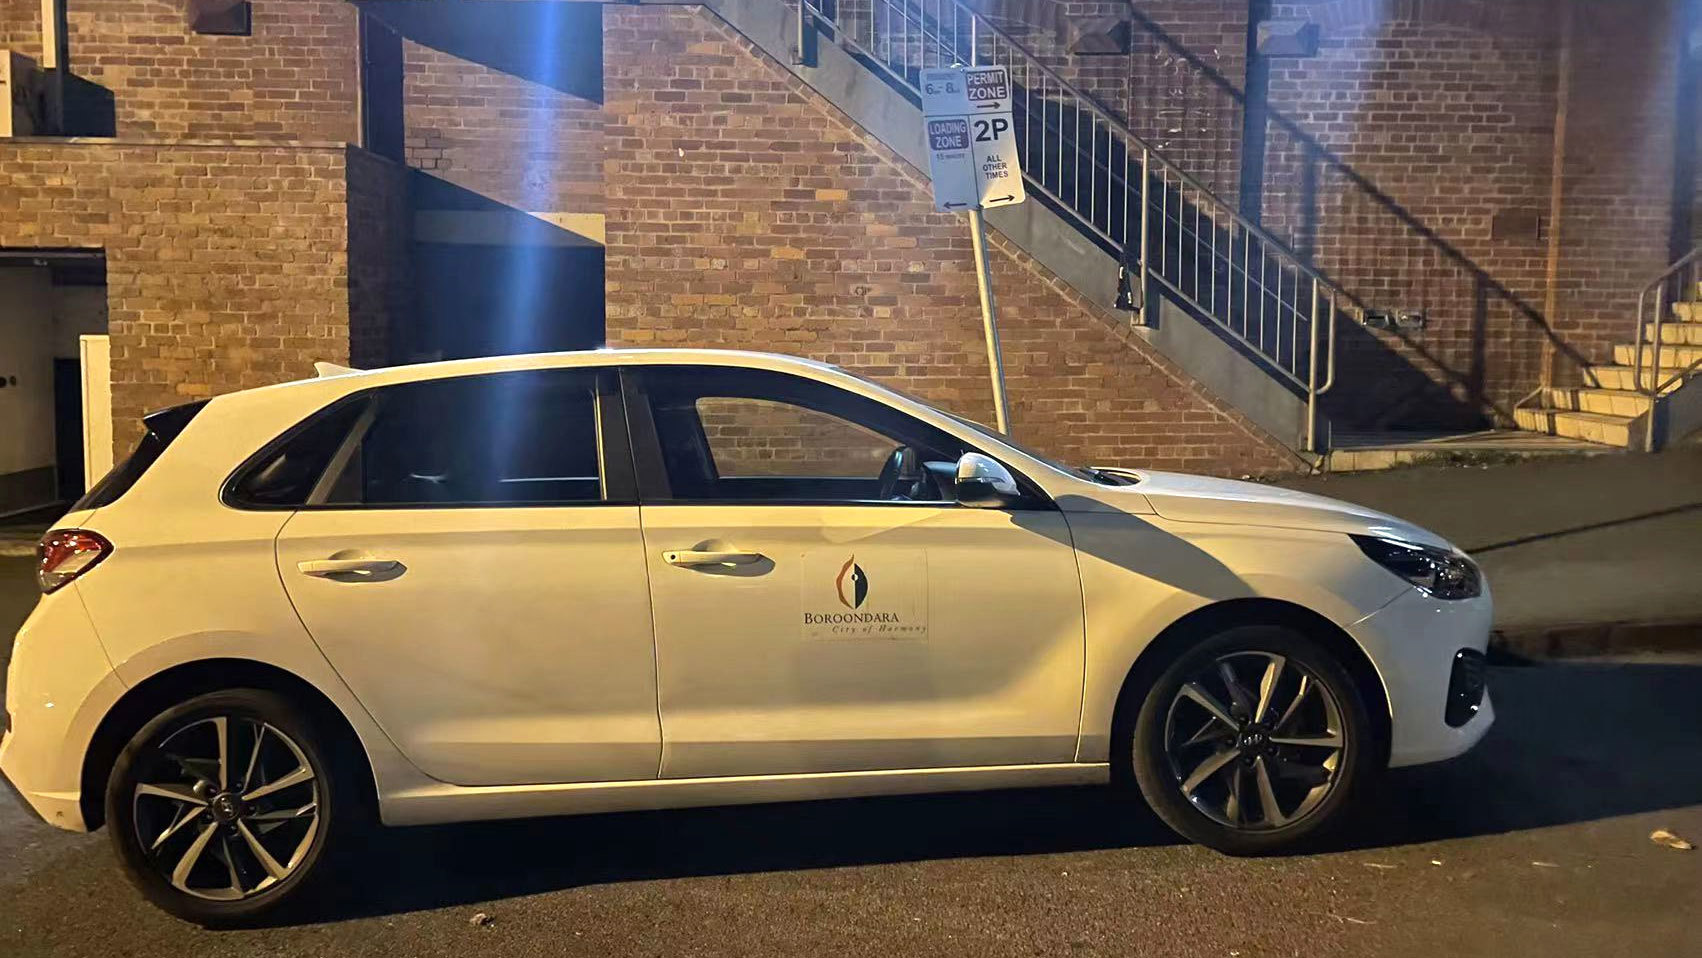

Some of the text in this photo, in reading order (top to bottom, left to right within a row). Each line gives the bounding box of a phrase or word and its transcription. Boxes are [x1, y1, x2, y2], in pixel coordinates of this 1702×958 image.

[967, 72, 1004, 85] PERMIT
[969, 86, 1006, 100] ZONE
[929, 122, 966, 135] LOADING
[974, 118, 1009, 142] 2P
[935, 136, 962, 148] ZONE
[986, 154, 1002, 163] ALL
[982, 163, 1008, 171] OTHER
[985, 171, 1008, 179] TIMES
[832, 624, 927, 635] City of Harmony
